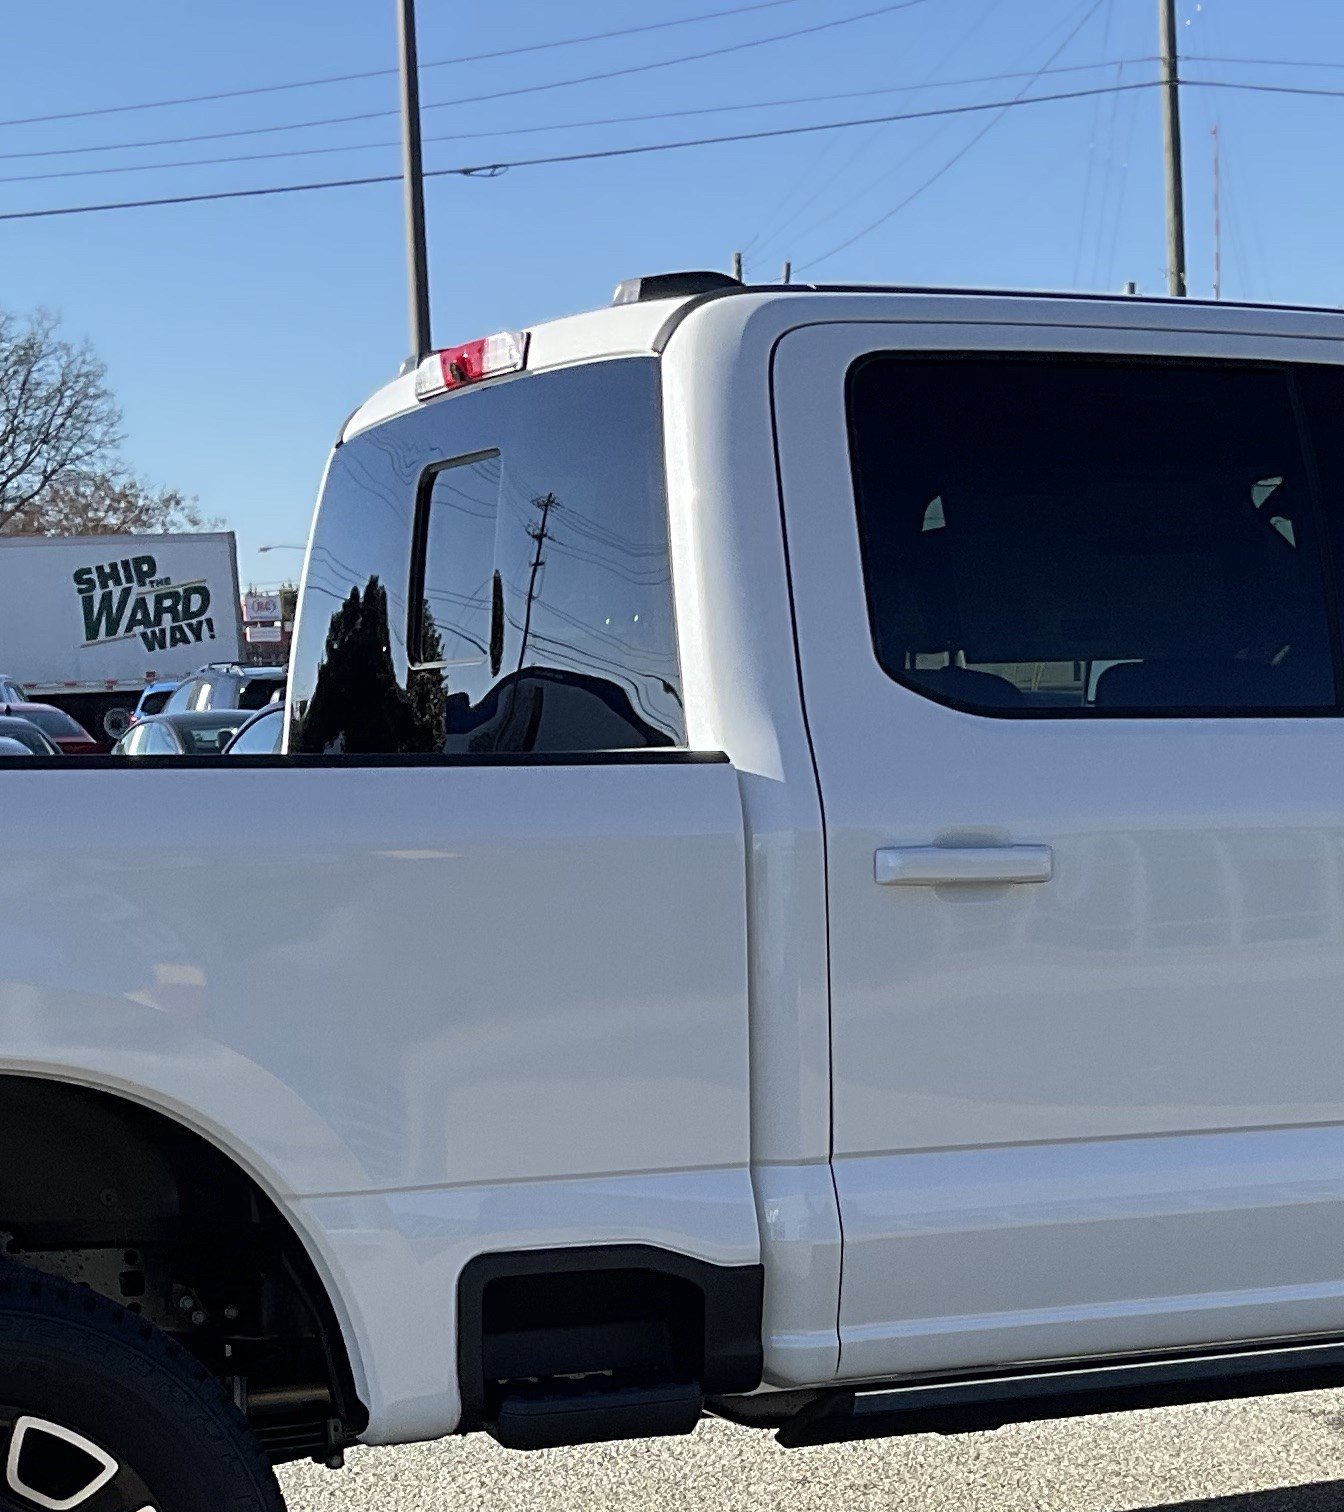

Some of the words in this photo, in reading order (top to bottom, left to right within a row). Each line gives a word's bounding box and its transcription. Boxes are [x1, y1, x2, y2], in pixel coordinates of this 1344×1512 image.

[72, 555, 157, 595] SHIP
[148, 577, 172, 589] THE
[80, 585, 211, 642] WARD
[140, 617, 217, 653] WAY!
